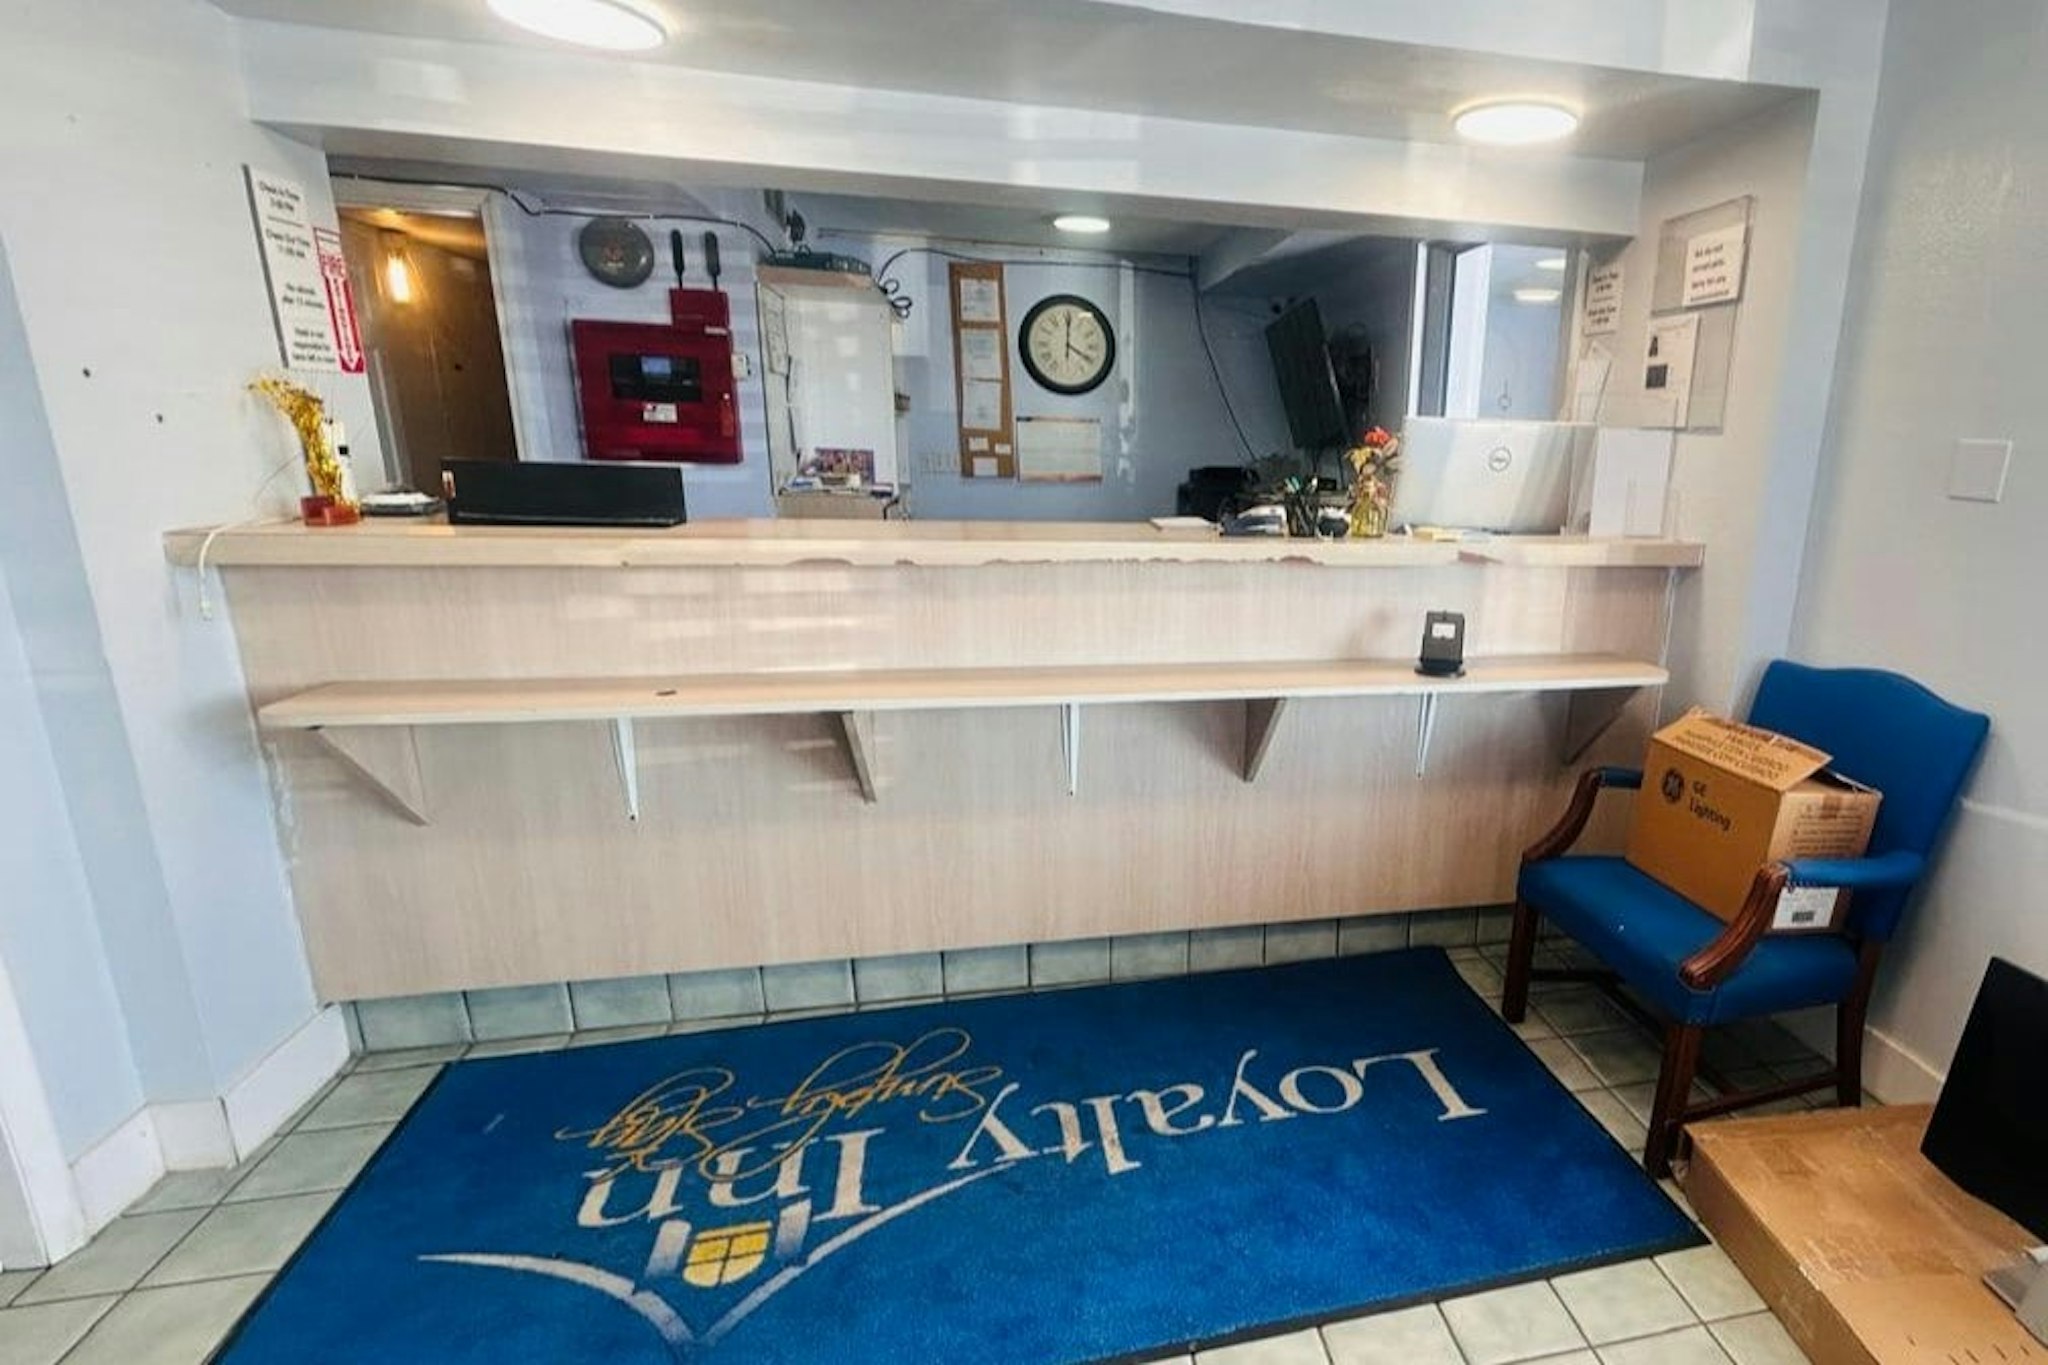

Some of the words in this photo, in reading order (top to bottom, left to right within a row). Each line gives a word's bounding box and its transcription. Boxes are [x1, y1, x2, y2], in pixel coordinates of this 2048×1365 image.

[1689, 796, 1732, 832] Lighting
[947, 1047, 1489, 1175] Loyalty
[577, 1127, 886, 1229] Inn
